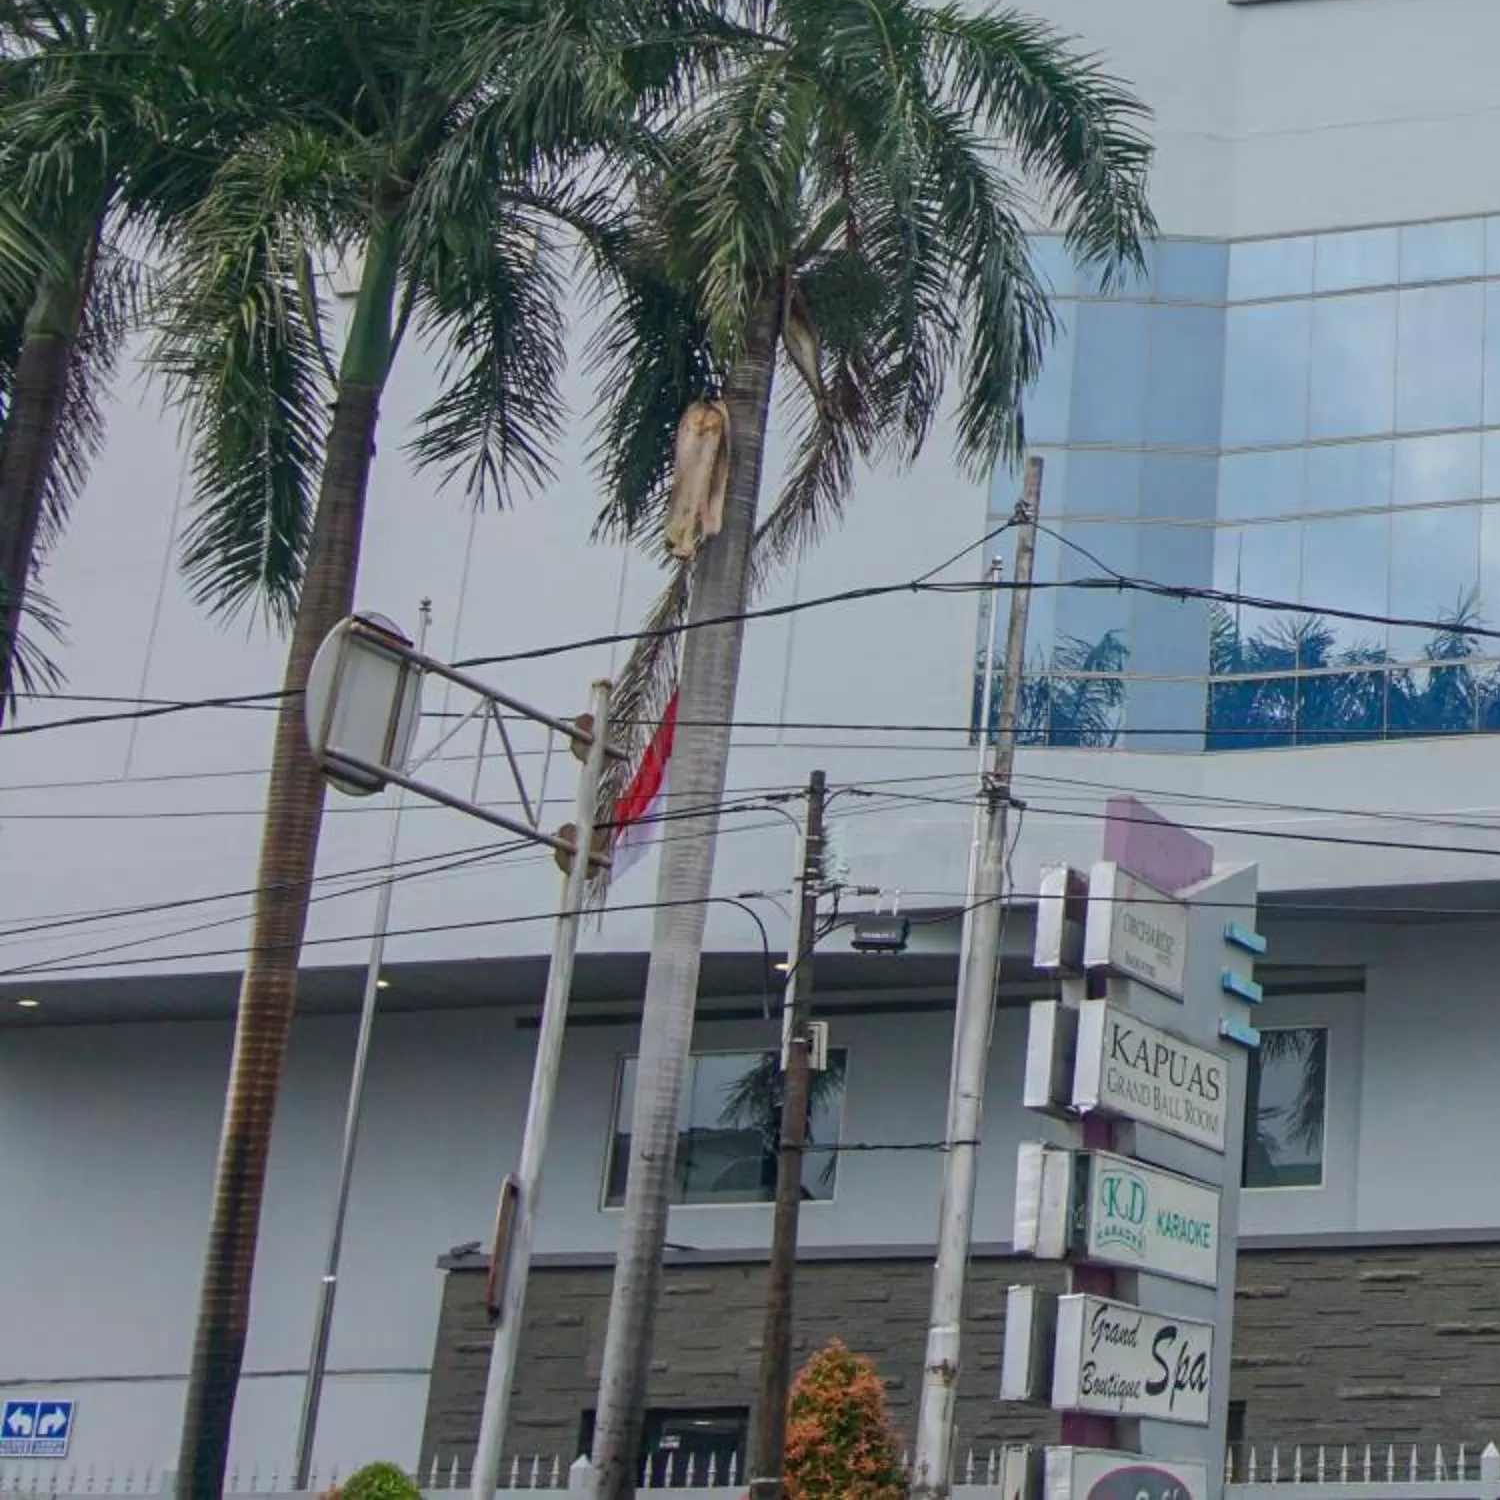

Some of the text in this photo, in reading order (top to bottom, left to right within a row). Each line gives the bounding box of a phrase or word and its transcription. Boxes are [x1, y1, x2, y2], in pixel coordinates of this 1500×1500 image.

[1110, 1023, 1220, 1101] KAPUAS
[1106, 1066, 1219, 1134] GRAND BALL ROOM
[1157, 1208, 1211, 1249] KARAOKE
[1091, 1303, 1143, 1353] Grand
[1081, 1360, 1141, 1411] Boutique
[1144, 1324, 1208, 1412] Spa
